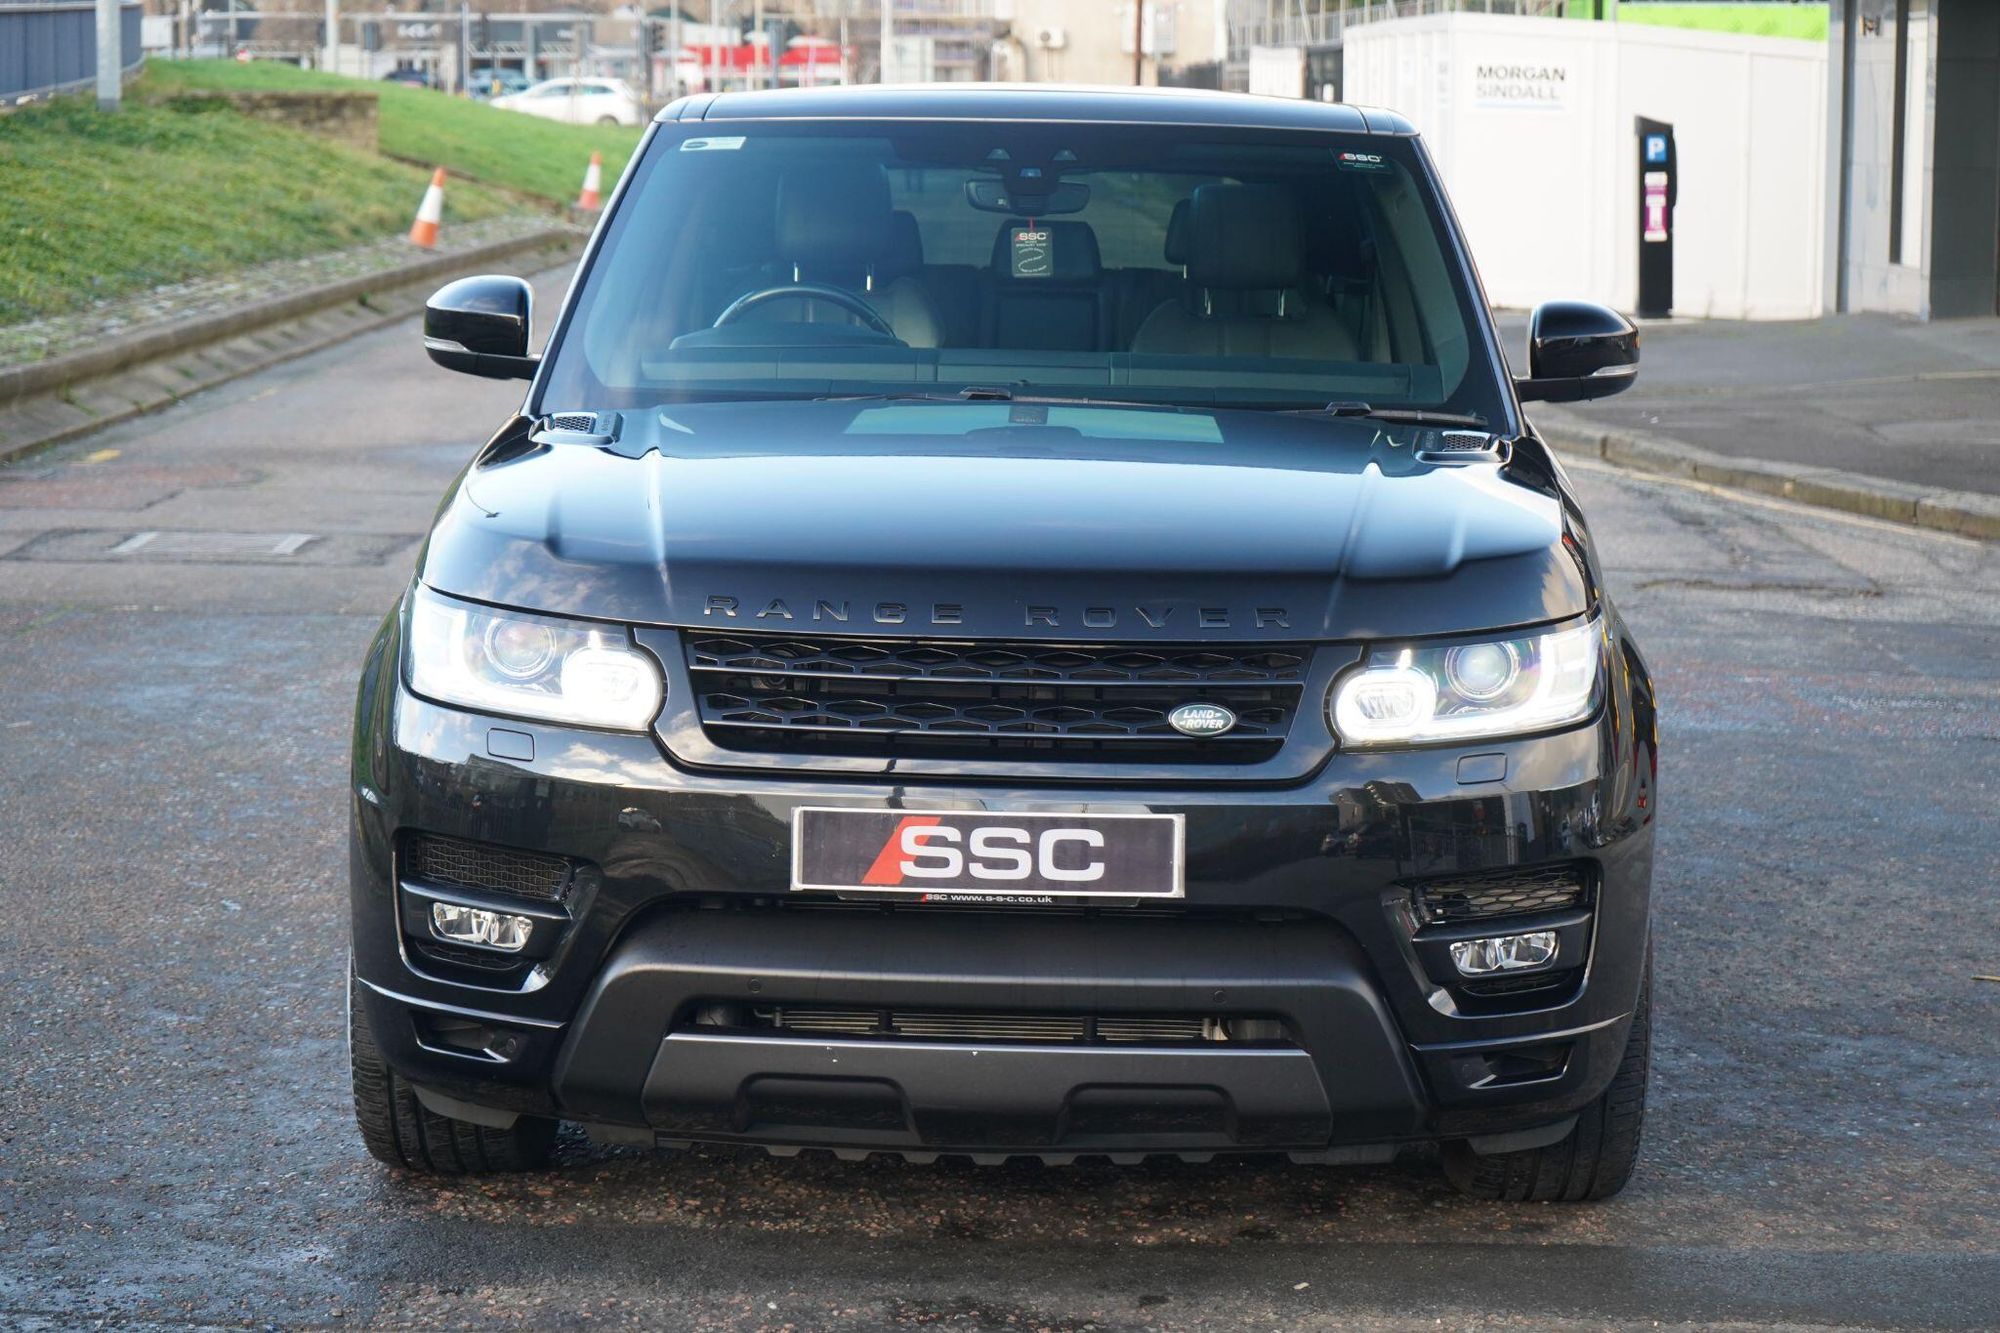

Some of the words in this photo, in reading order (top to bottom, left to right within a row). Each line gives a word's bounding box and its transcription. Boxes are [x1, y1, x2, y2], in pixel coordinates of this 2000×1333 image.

[1476, 65, 1565, 81] MORGAN
[1476, 83, 1560, 99] SINDALL
[1647, 136, 1666, 161] P
[1018, 231, 1047, 241] SSC
[703, 594, 963, 624] RANGE
[1025, 604, 1291, 628] ROVER
[1183, 709, 1215, 719] LAND
[1185, 719, 1224, 729] ROVER
[900, 825, 1105, 882] SSC
[925, 893, 948, 901] SSC
[951, 894, 1053, 904] www.s-s-c.co.uk
